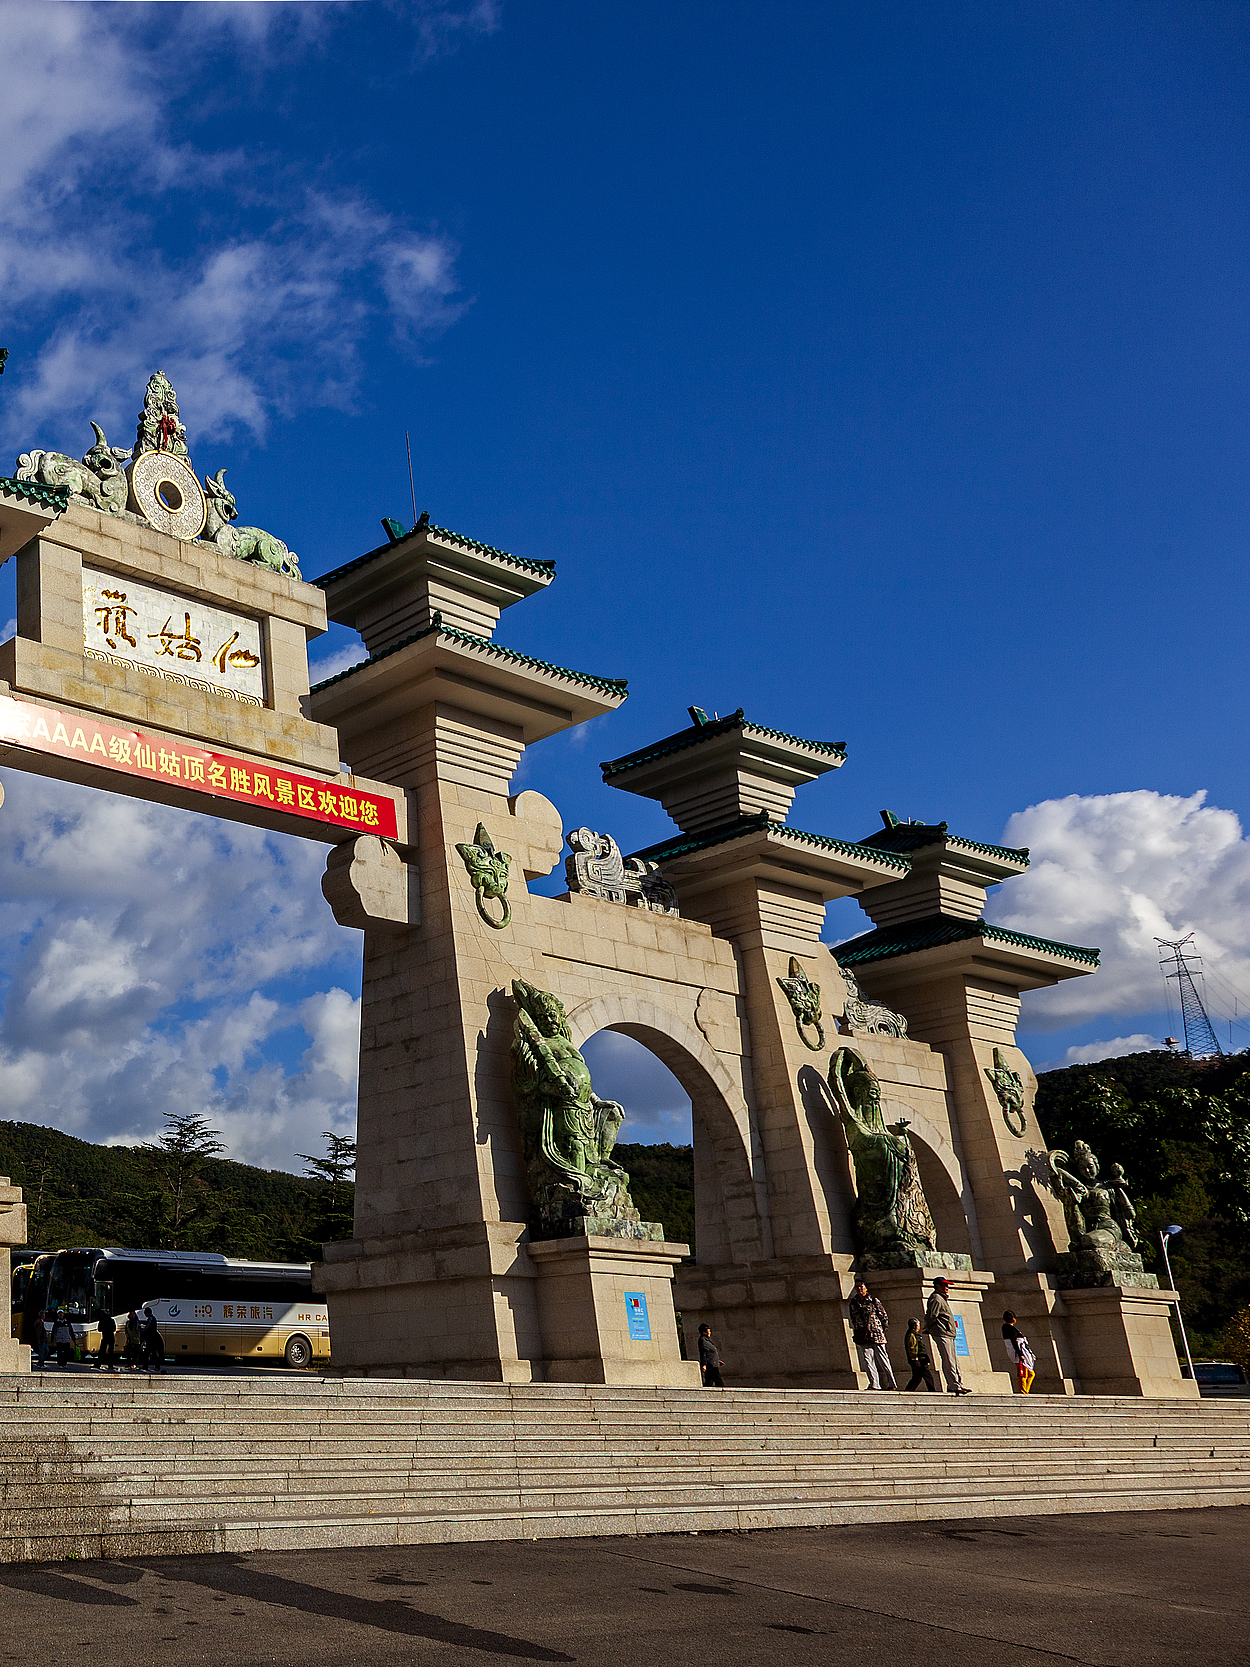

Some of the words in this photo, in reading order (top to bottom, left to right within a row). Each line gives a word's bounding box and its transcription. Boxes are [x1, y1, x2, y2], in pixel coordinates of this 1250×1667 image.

[223, 1304, 274, 1320] 辉荣旅汽
[297, 1313, 311, 1321] HR
